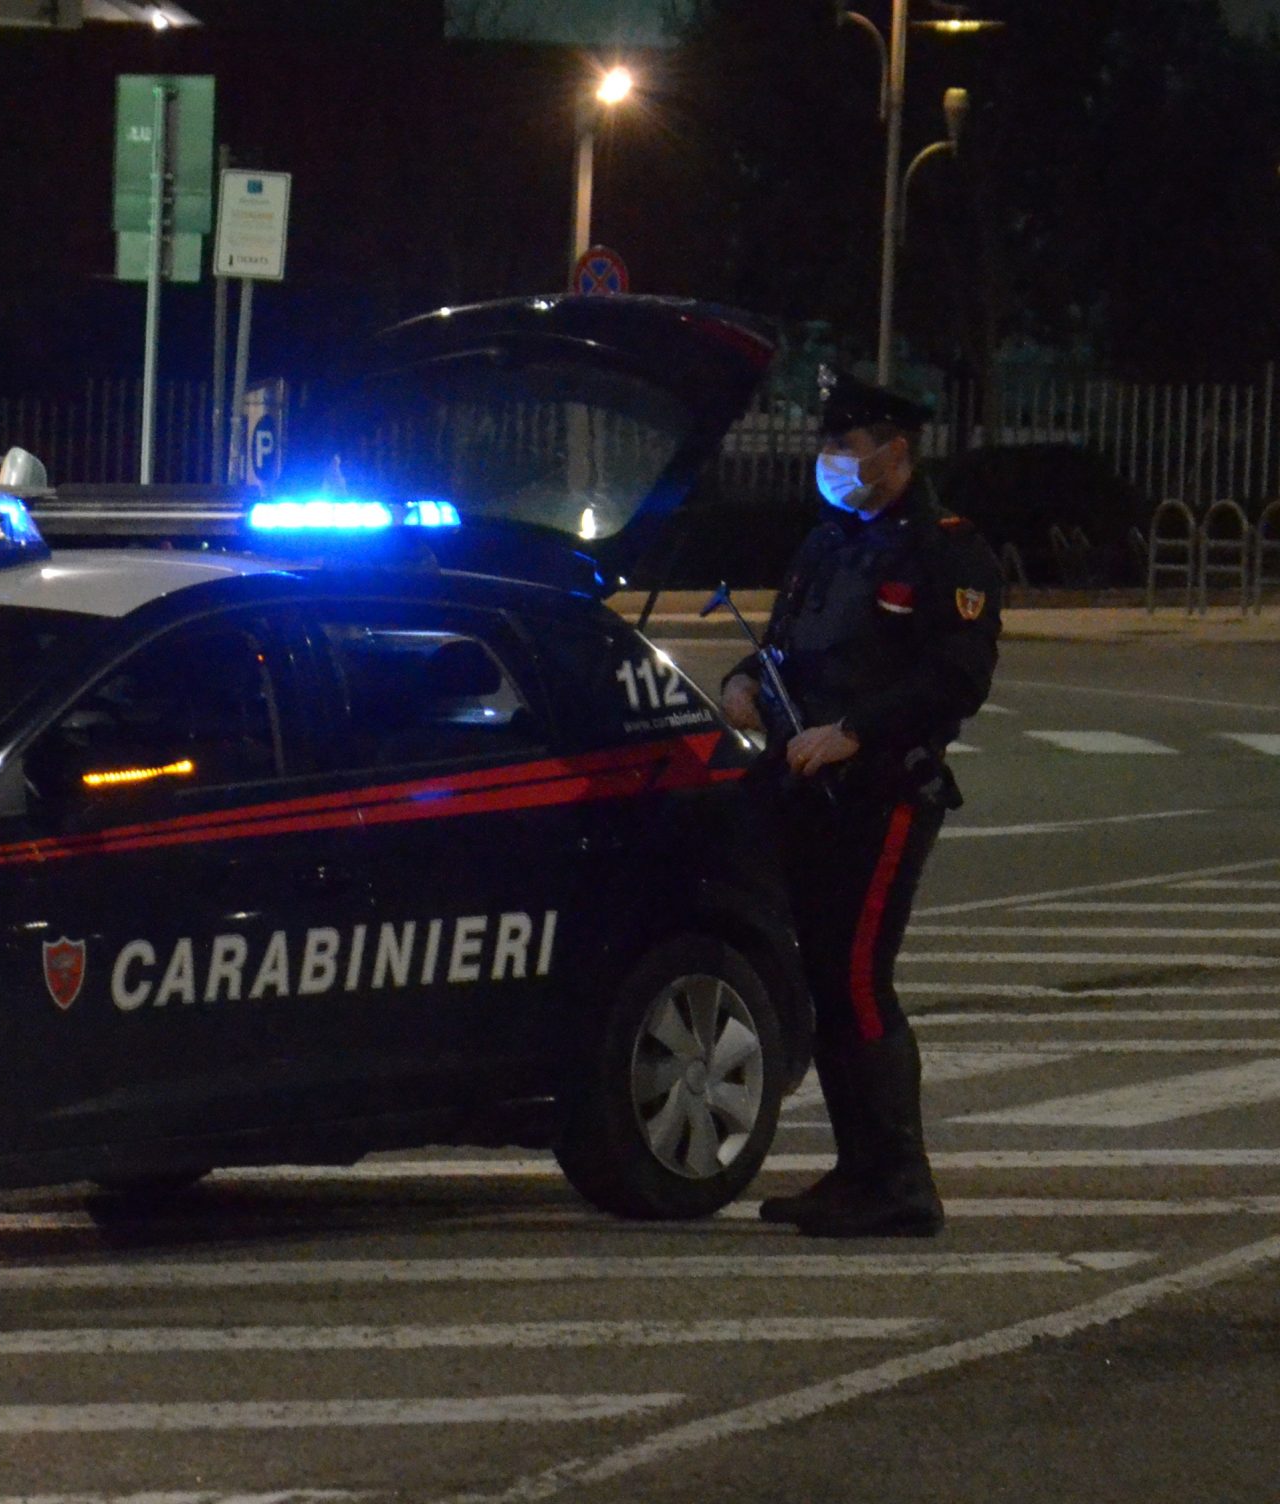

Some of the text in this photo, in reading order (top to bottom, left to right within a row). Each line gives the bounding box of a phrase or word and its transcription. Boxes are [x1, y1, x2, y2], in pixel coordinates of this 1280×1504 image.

[256, 430, 274, 469] P
[616, 657, 688, 712] 112
[111, 910, 558, 1011] CARABINIERI
